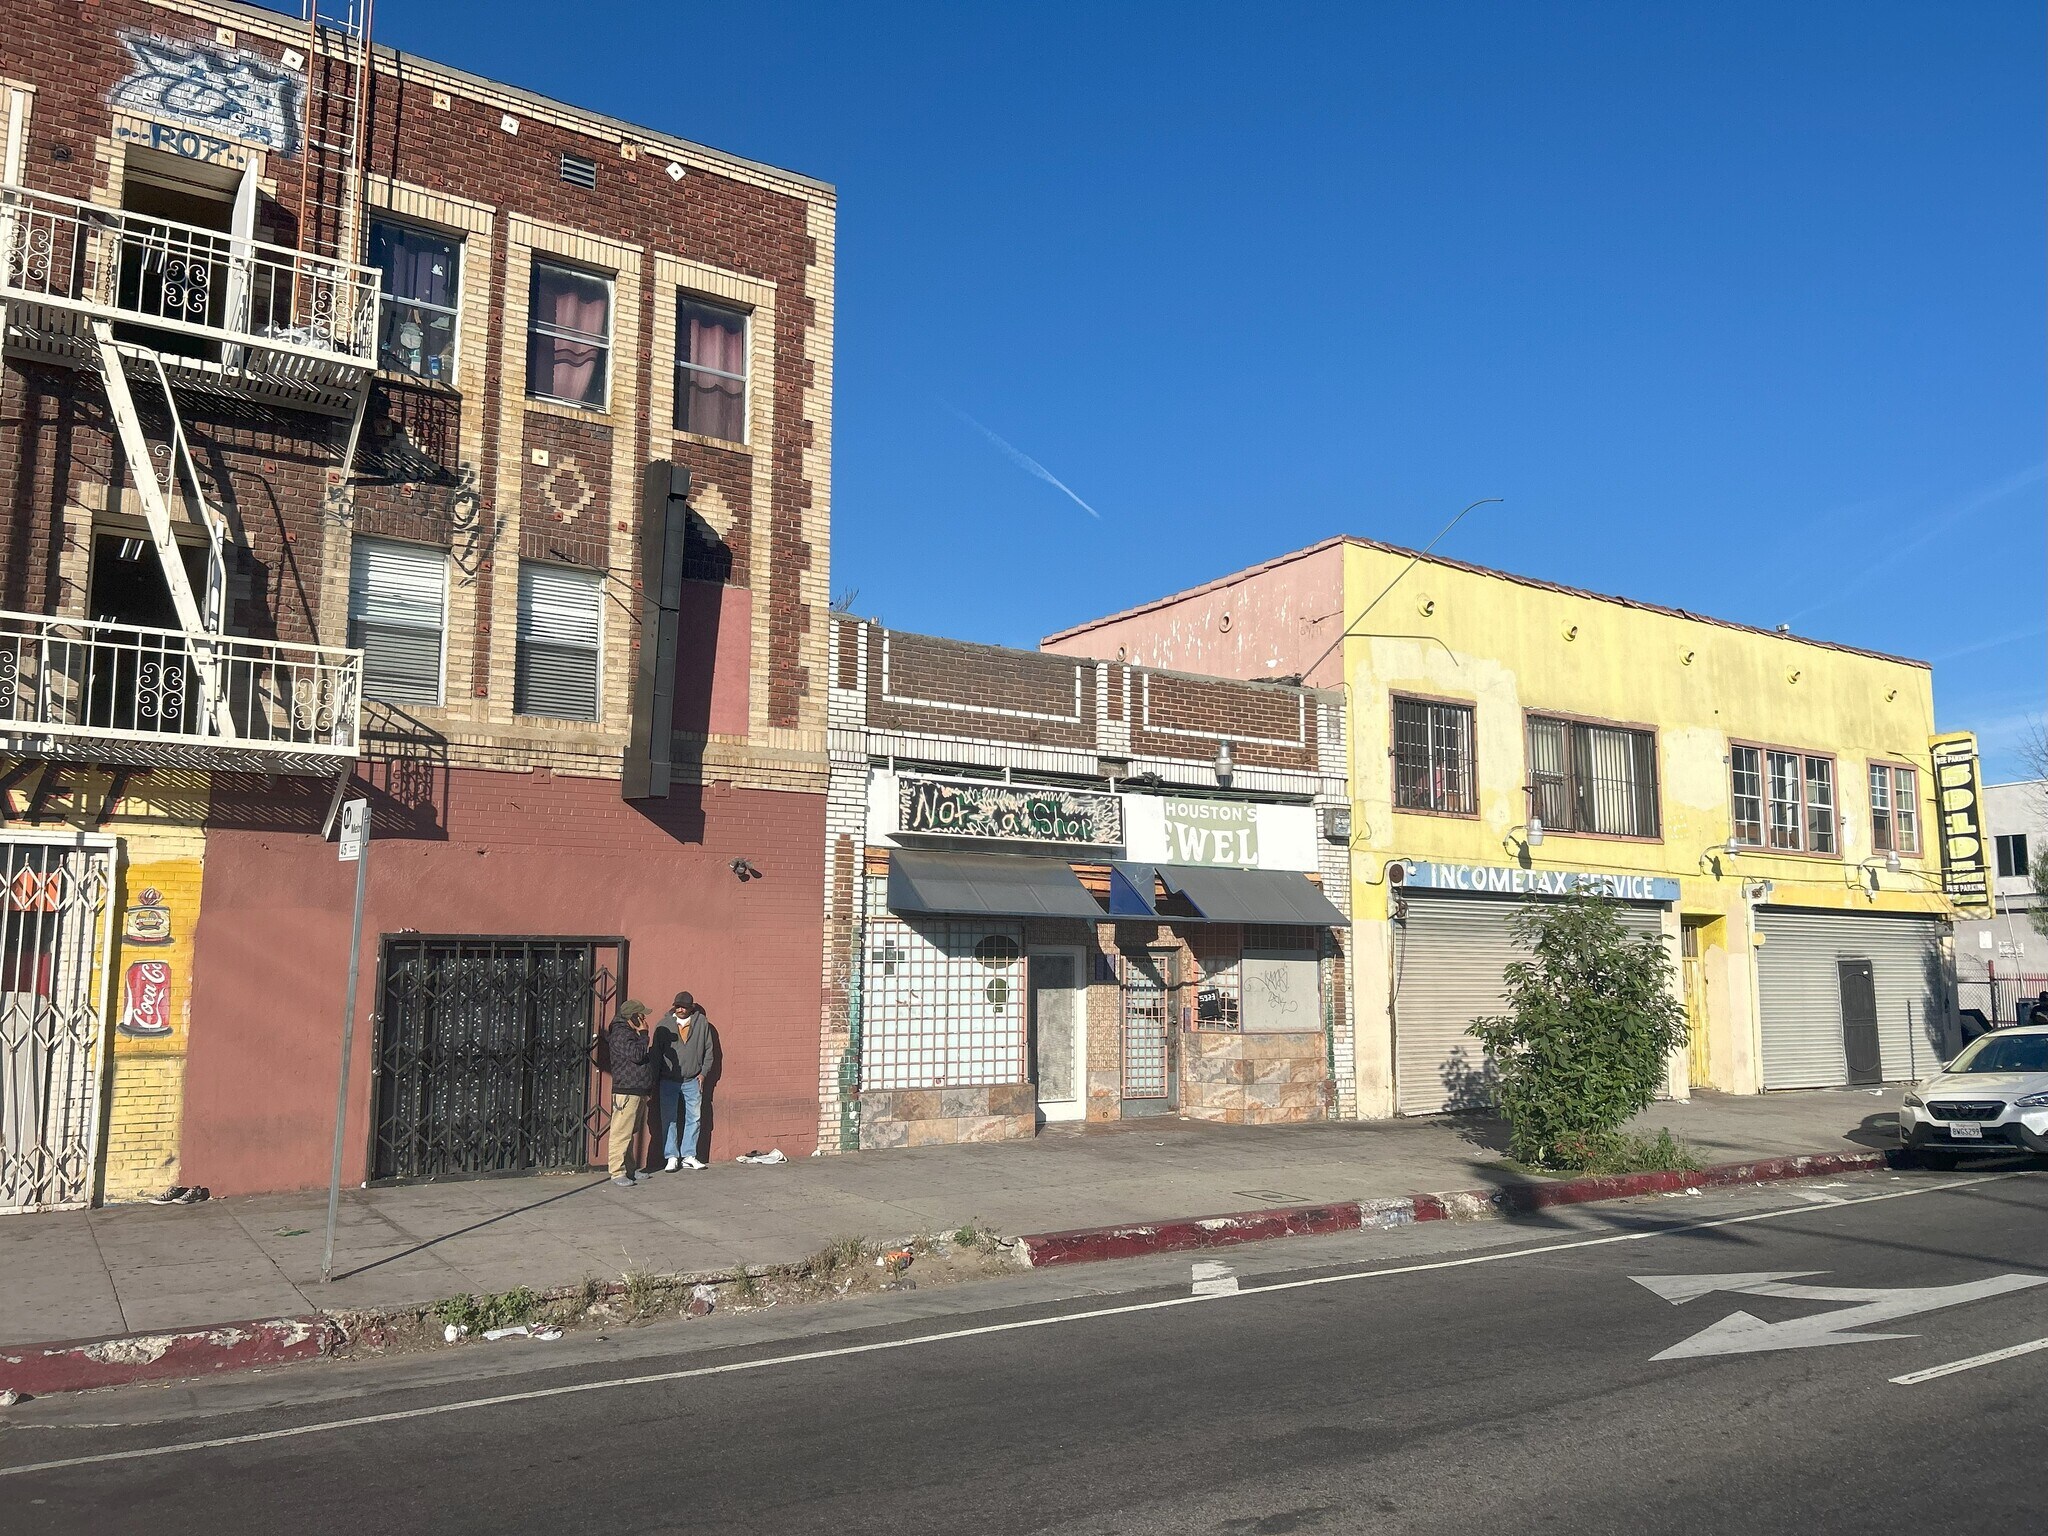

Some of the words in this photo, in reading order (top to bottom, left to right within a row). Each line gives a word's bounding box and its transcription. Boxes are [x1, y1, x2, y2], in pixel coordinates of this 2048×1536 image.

[913, 786, 971, 829] Not
[1001, 813, 1020, 833] a
[1032, 802, 1093, 839] Shop
[1165, 802, 1257, 822] HOUSTON'S
[1960, 883, 1987, 892] PARKING
